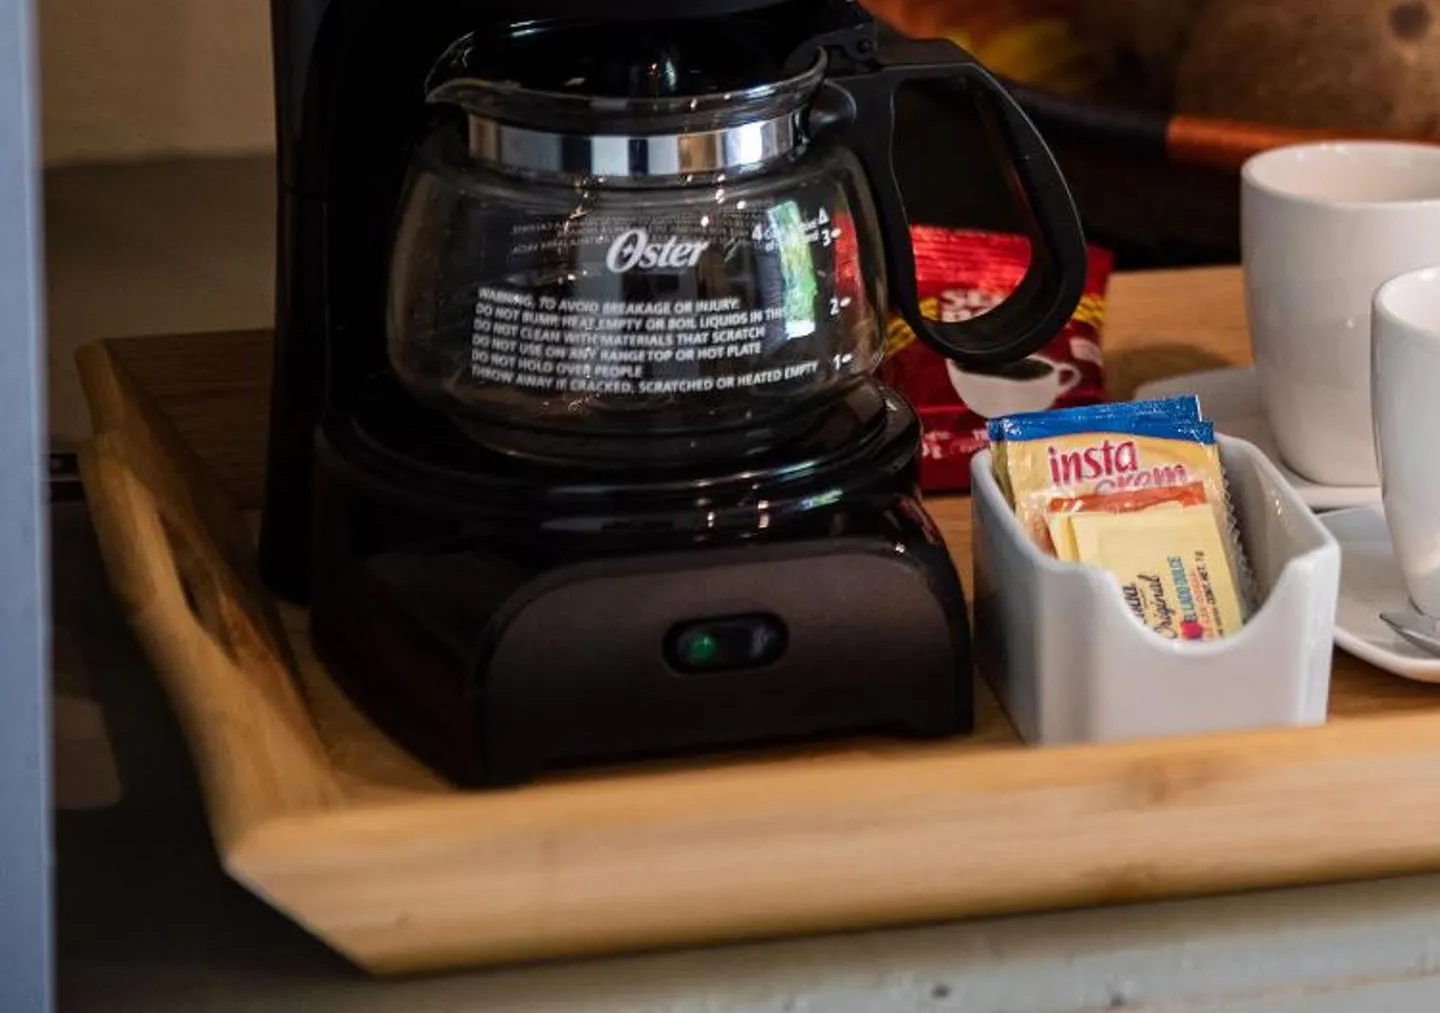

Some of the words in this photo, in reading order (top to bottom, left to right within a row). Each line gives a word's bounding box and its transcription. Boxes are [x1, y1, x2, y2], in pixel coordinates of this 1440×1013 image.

[606, 228, 710, 273] Oster
[475, 302, 493, 317] DO
[495, 307, 520, 321] NOT
[562, 315, 596, 329] HEAT
[599, 317, 642, 332] EMPTY
[645, 316, 665, 331] OR
[668, 315, 697, 331] BOIL
[700, 311, 748, 329] LIQUIDS
[750, 310, 763, 324] IN
[540, 295, 556, 311] TO
[558, 299, 600, 313] AVOID
[602, 301, 671, 316] BREAKAGE
[674, 300, 693, 314] OR
[472, 333, 490, 348] DO
[491, 337, 517, 352] NOT
[520, 342, 543, 357] USE
[545, 346, 566, 360] ON
[568, 346, 597, 361] ANY
[675, 347, 695, 362] OR
[697, 345, 726, 361] HOT
[727, 341, 762, 358] PLATE
[473, 317, 492, 332] DO
[493, 321, 519, 338] NOT
[520, 327, 561, 343] CLEAN
[563, 330, 598, 345] WITH
[600, 333, 674, 348] MATERIALS
[677, 330, 709, 345] THAT
[712, 326, 766, 344] SCRATCH
[472, 349, 490, 364] DO
[491, 353, 517, 368] NOT
[518, 357, 554, 374] HOLD
[556, 362, 591, 377] OVER
[593, 364, 643, 379] PEOPLE
[472, 362, 514, 384] THROW
[516, 374, 553, 388] AWAY
[638, 377, 714, 394] SCRATCHED
[716, 376, 735, 390] OR
[736, 369, 783, 387] HEATED
[784, 359, 820, 381] EMPTY
[1048, 440, 1138, 486] insta
